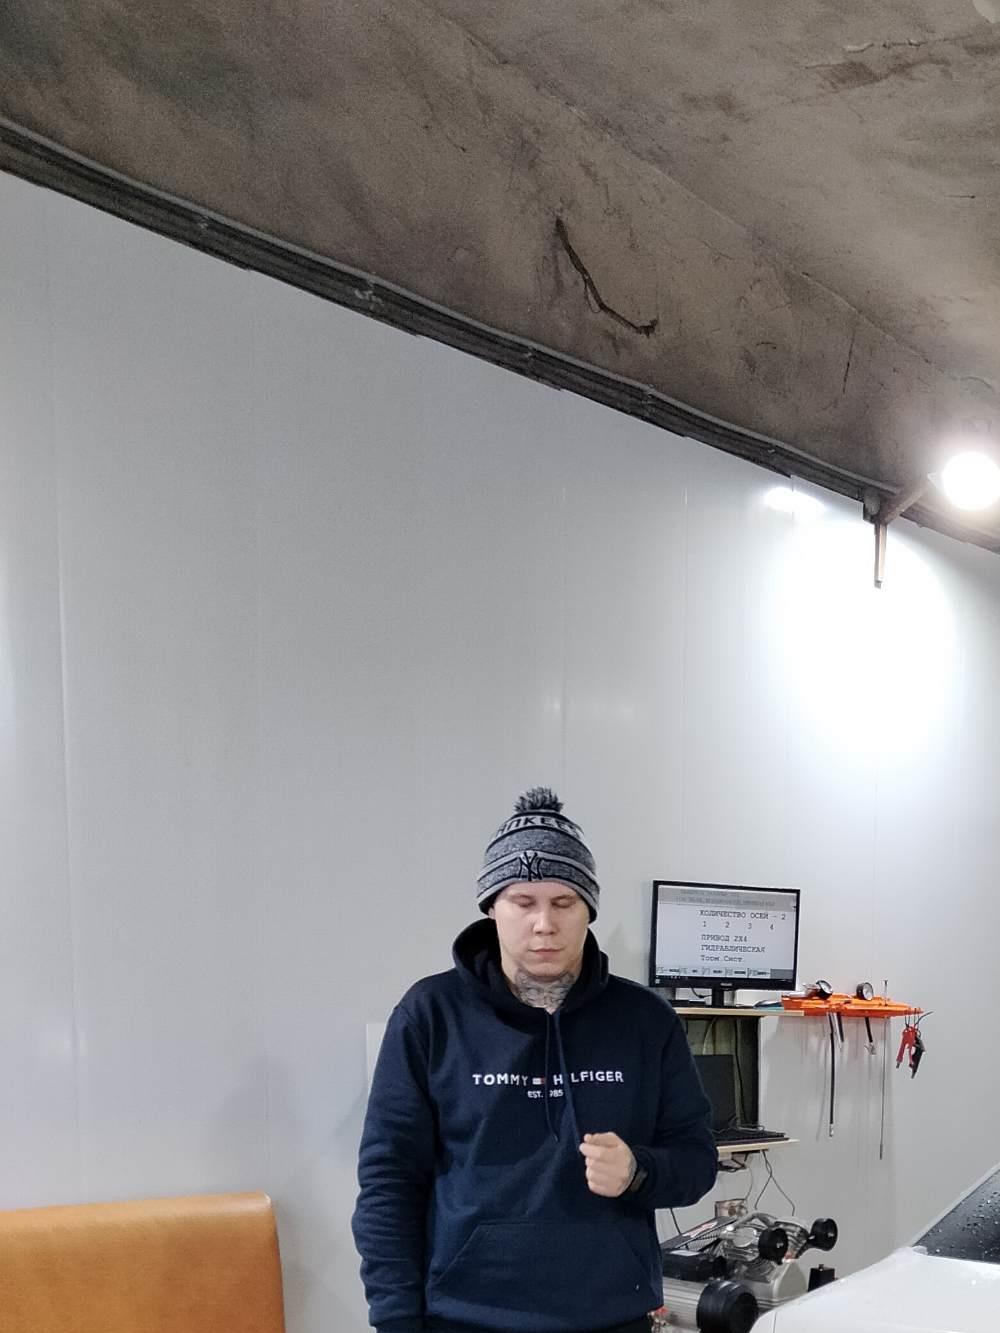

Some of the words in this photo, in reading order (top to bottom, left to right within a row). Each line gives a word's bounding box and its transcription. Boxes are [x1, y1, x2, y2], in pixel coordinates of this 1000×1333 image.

[699, 909, 747, 919] КОЛИЧЕСТВО
[472, 1073, 529, 1086] TOMMY
[553, 1070, 625, 1086] HLFIGER
